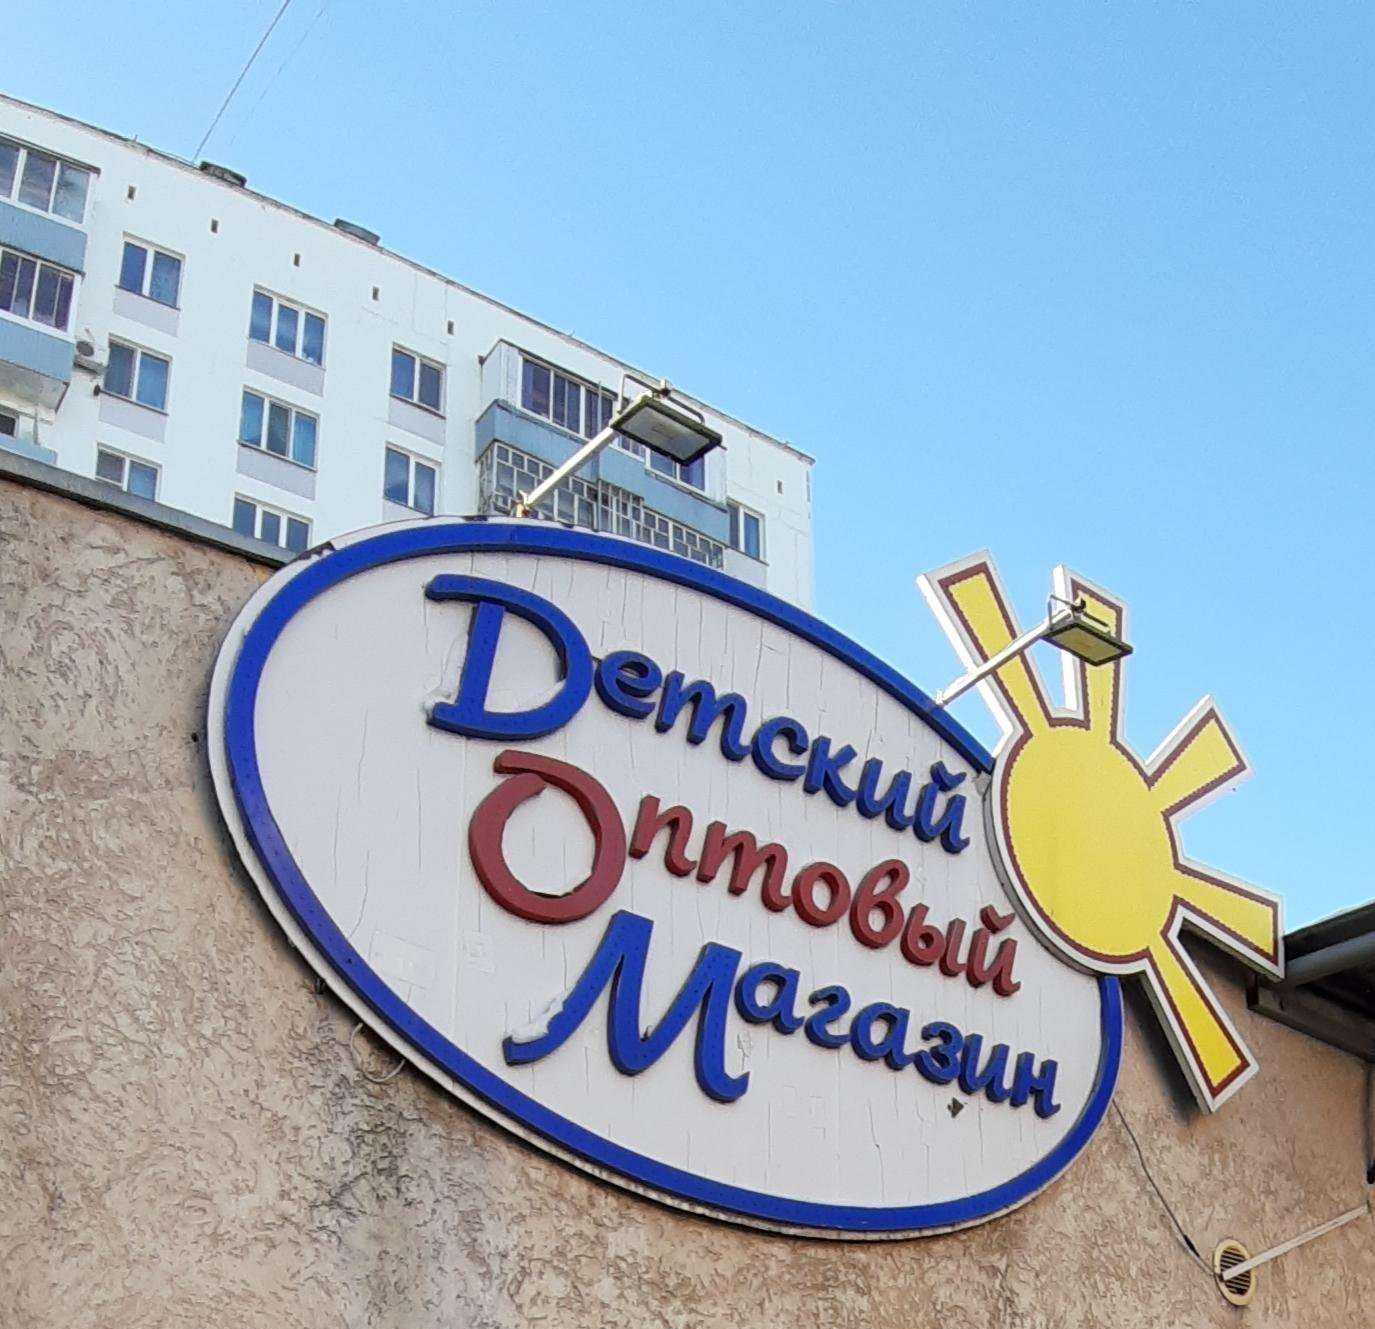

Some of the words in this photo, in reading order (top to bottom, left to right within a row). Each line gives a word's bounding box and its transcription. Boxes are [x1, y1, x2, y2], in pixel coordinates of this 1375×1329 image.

[425, 573, 970, 854] Детский
[468, 750, 1021, 997] Оптовый
[502, 910, 1061, 1119] Магазин
